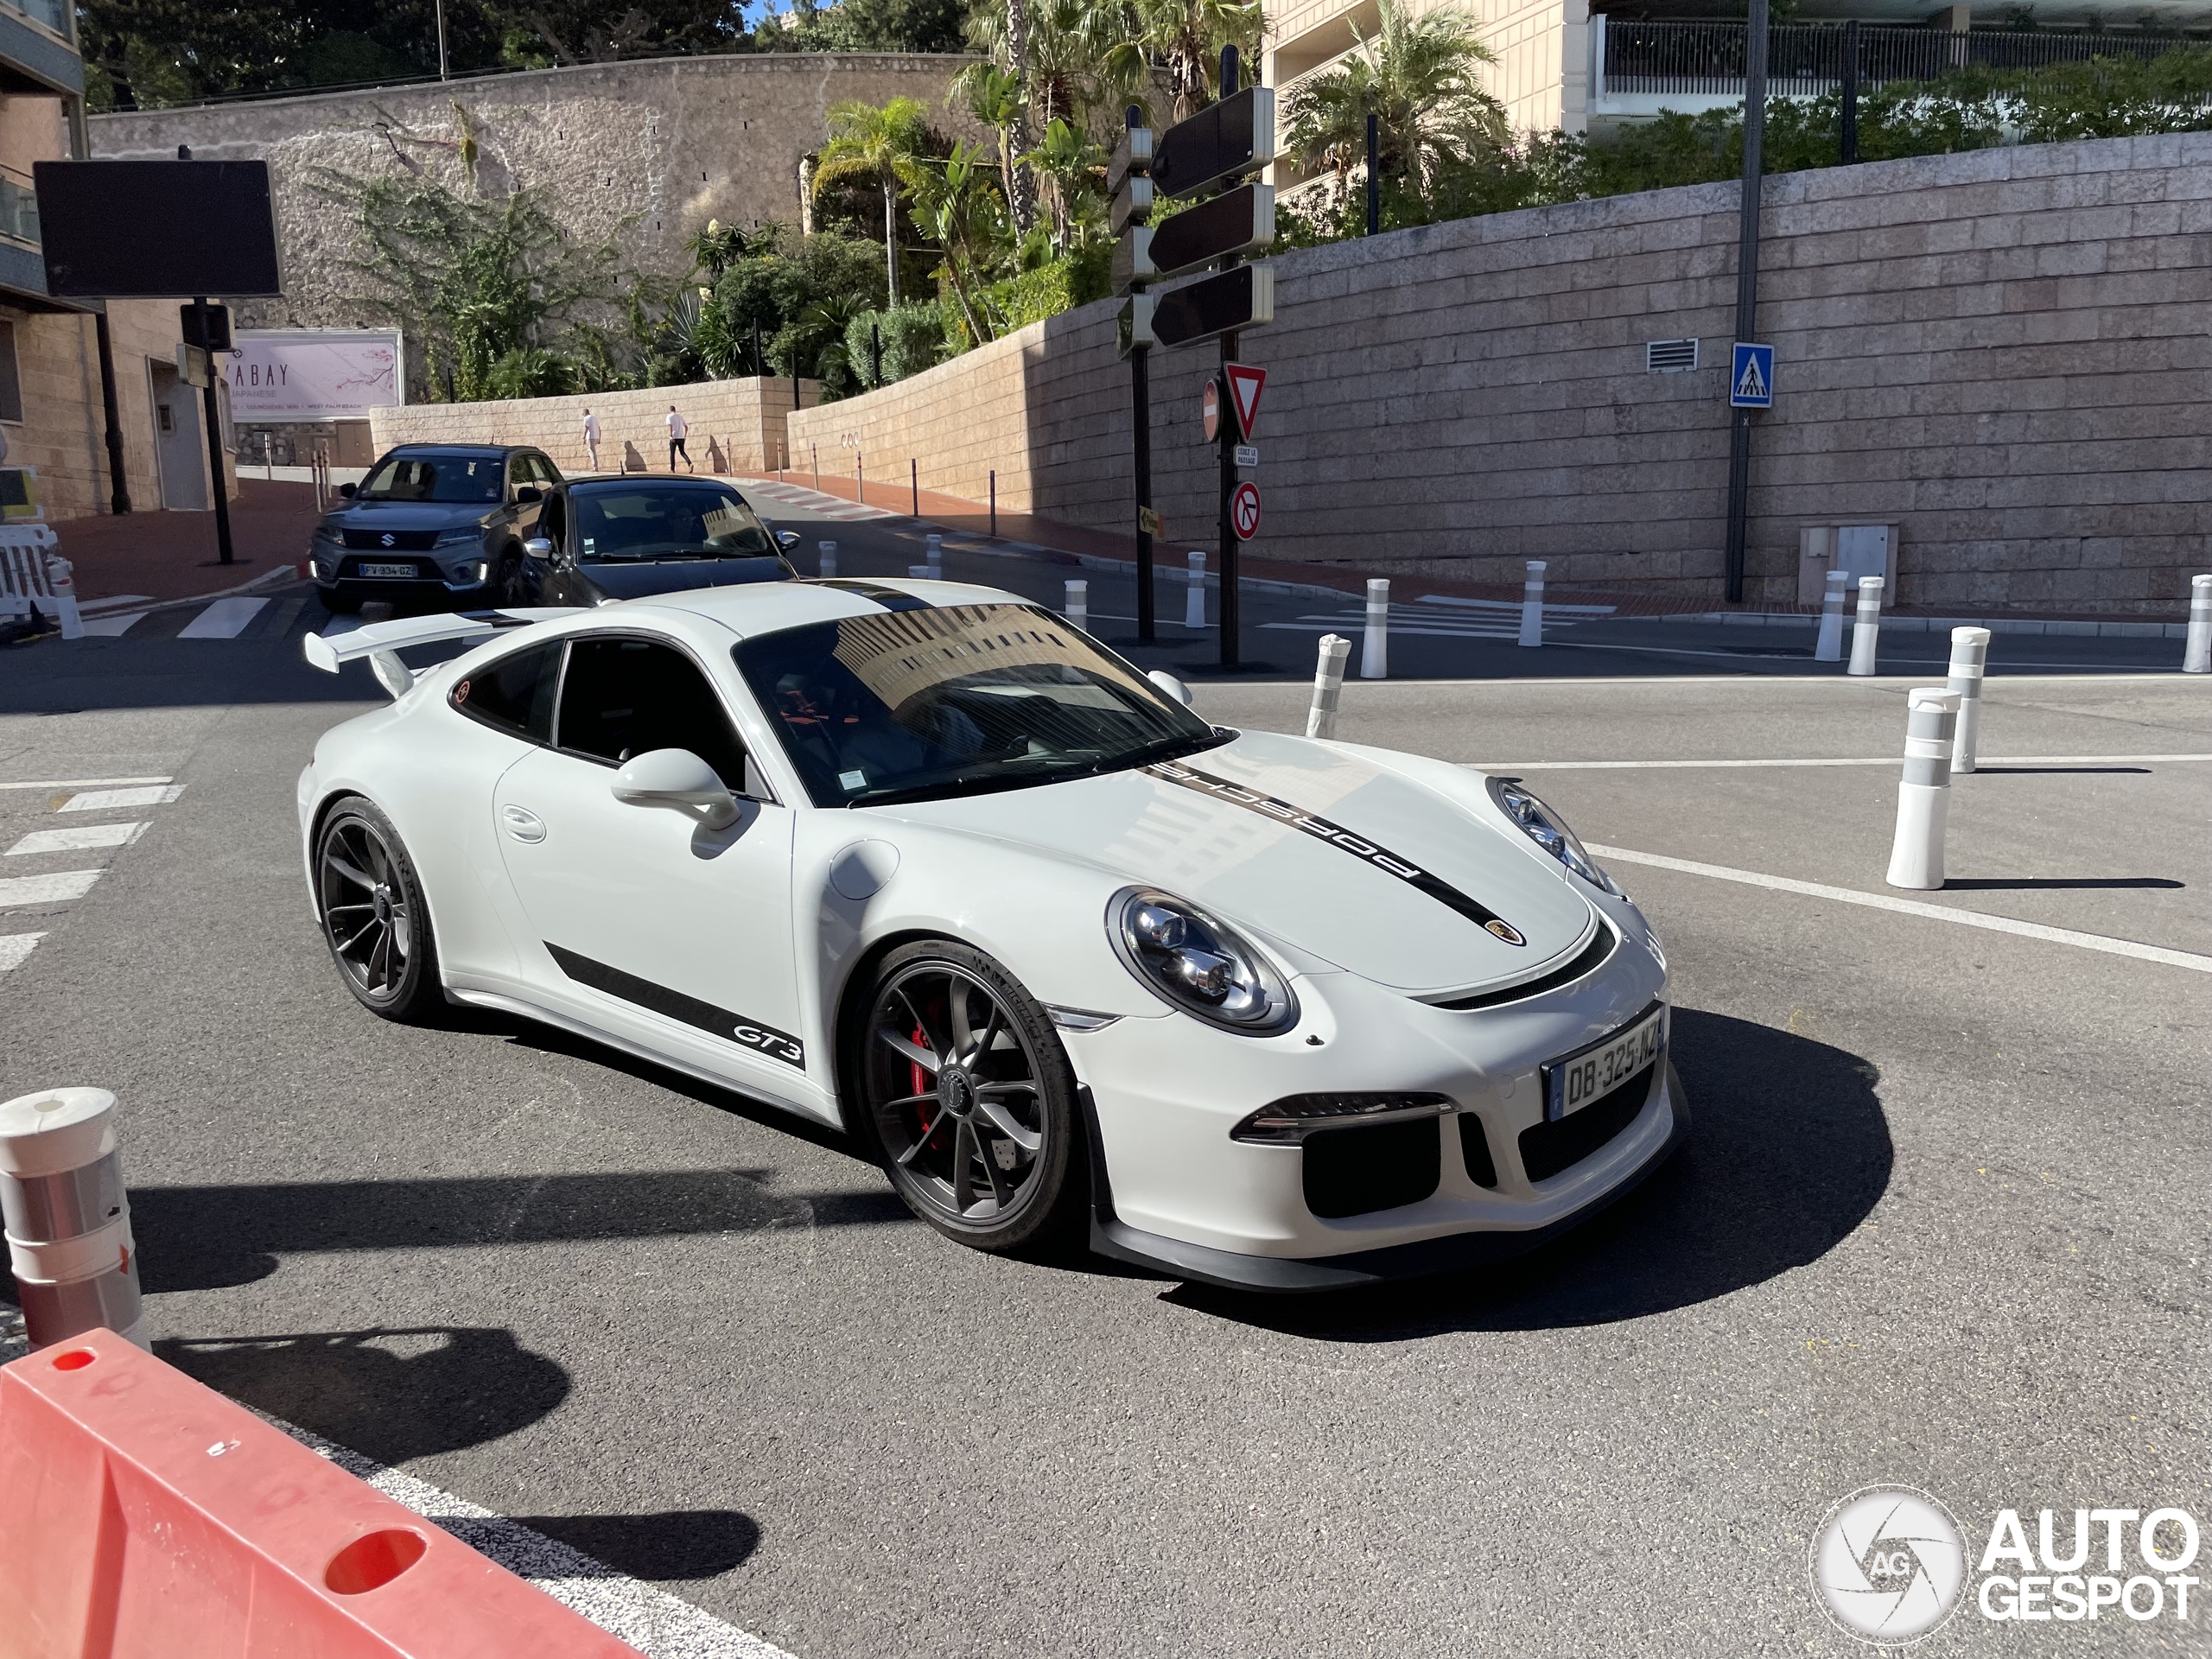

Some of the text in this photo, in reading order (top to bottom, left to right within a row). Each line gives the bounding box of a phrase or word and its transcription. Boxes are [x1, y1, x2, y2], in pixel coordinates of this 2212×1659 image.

[226, 364, 288, 386] ABAY
[1148, 761, 1421, 879] PORSCHE
[734, 1025, 802, 1061] GT3
